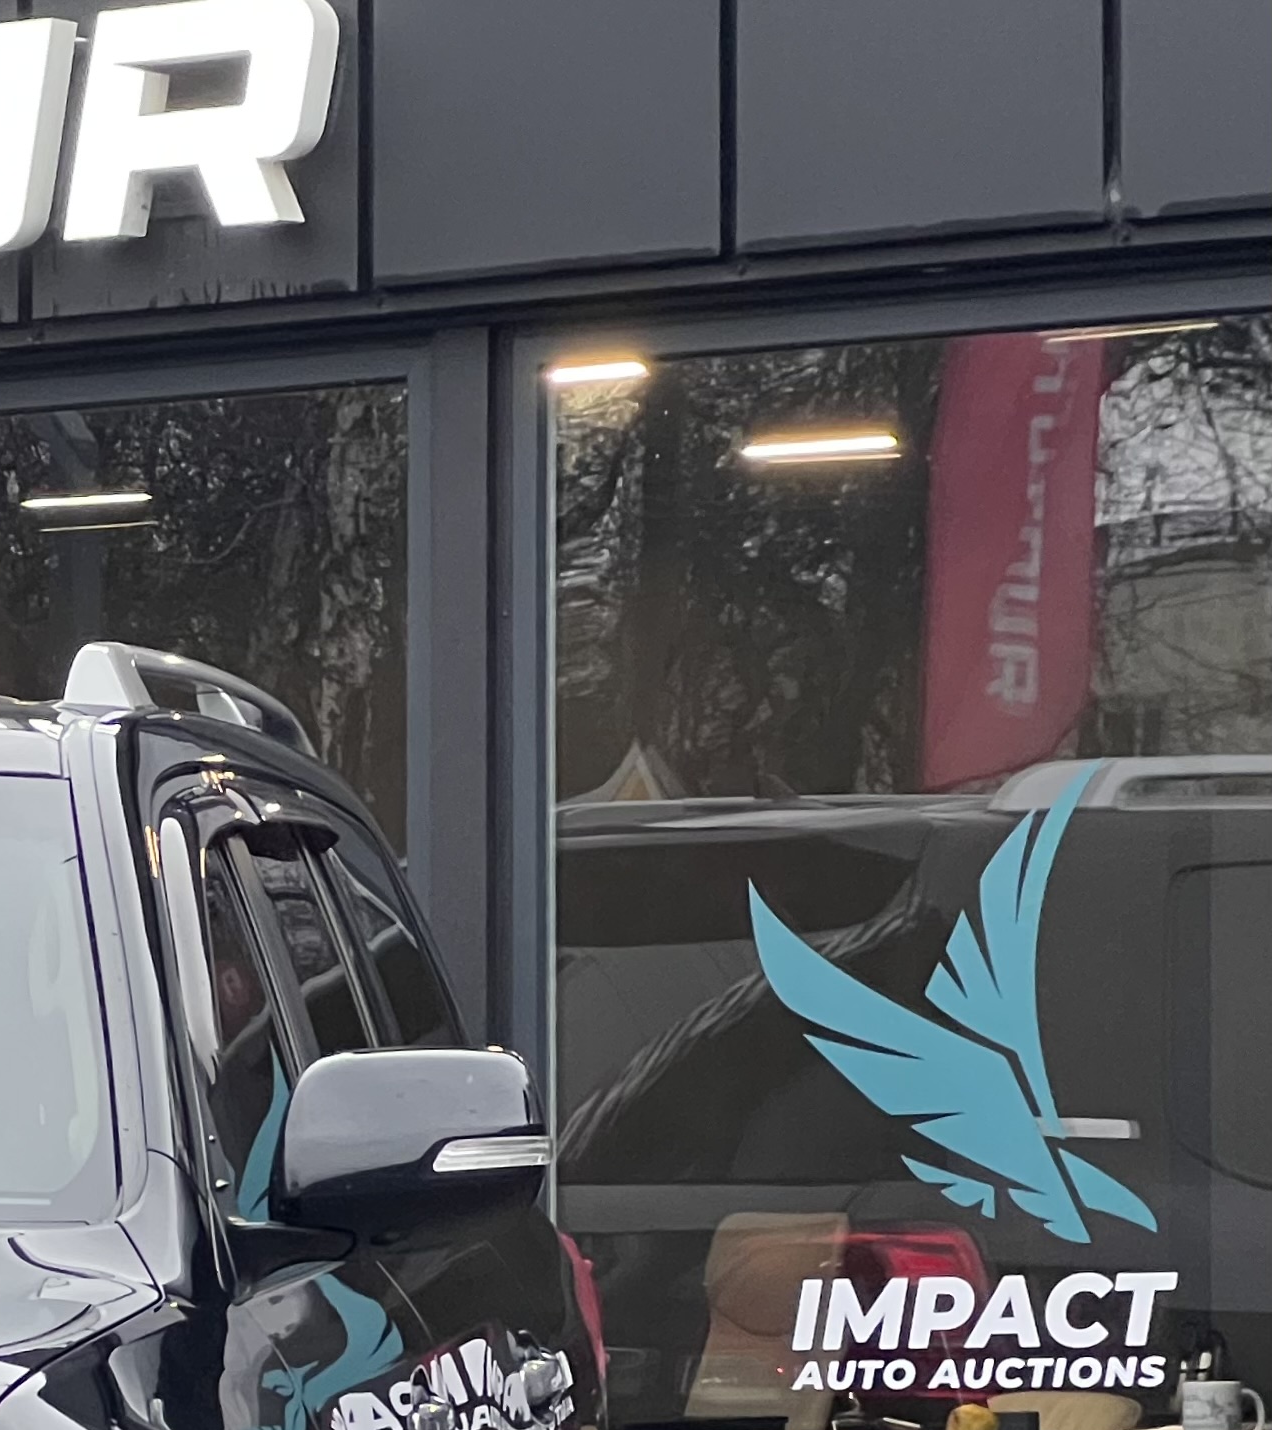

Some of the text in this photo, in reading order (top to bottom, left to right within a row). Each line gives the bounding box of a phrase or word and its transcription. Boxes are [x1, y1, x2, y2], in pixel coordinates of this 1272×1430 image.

[792, 1272, 1178, 1351] IMPACT
[792, 1356, 1166, 1390] AUTO AUCTIONS
